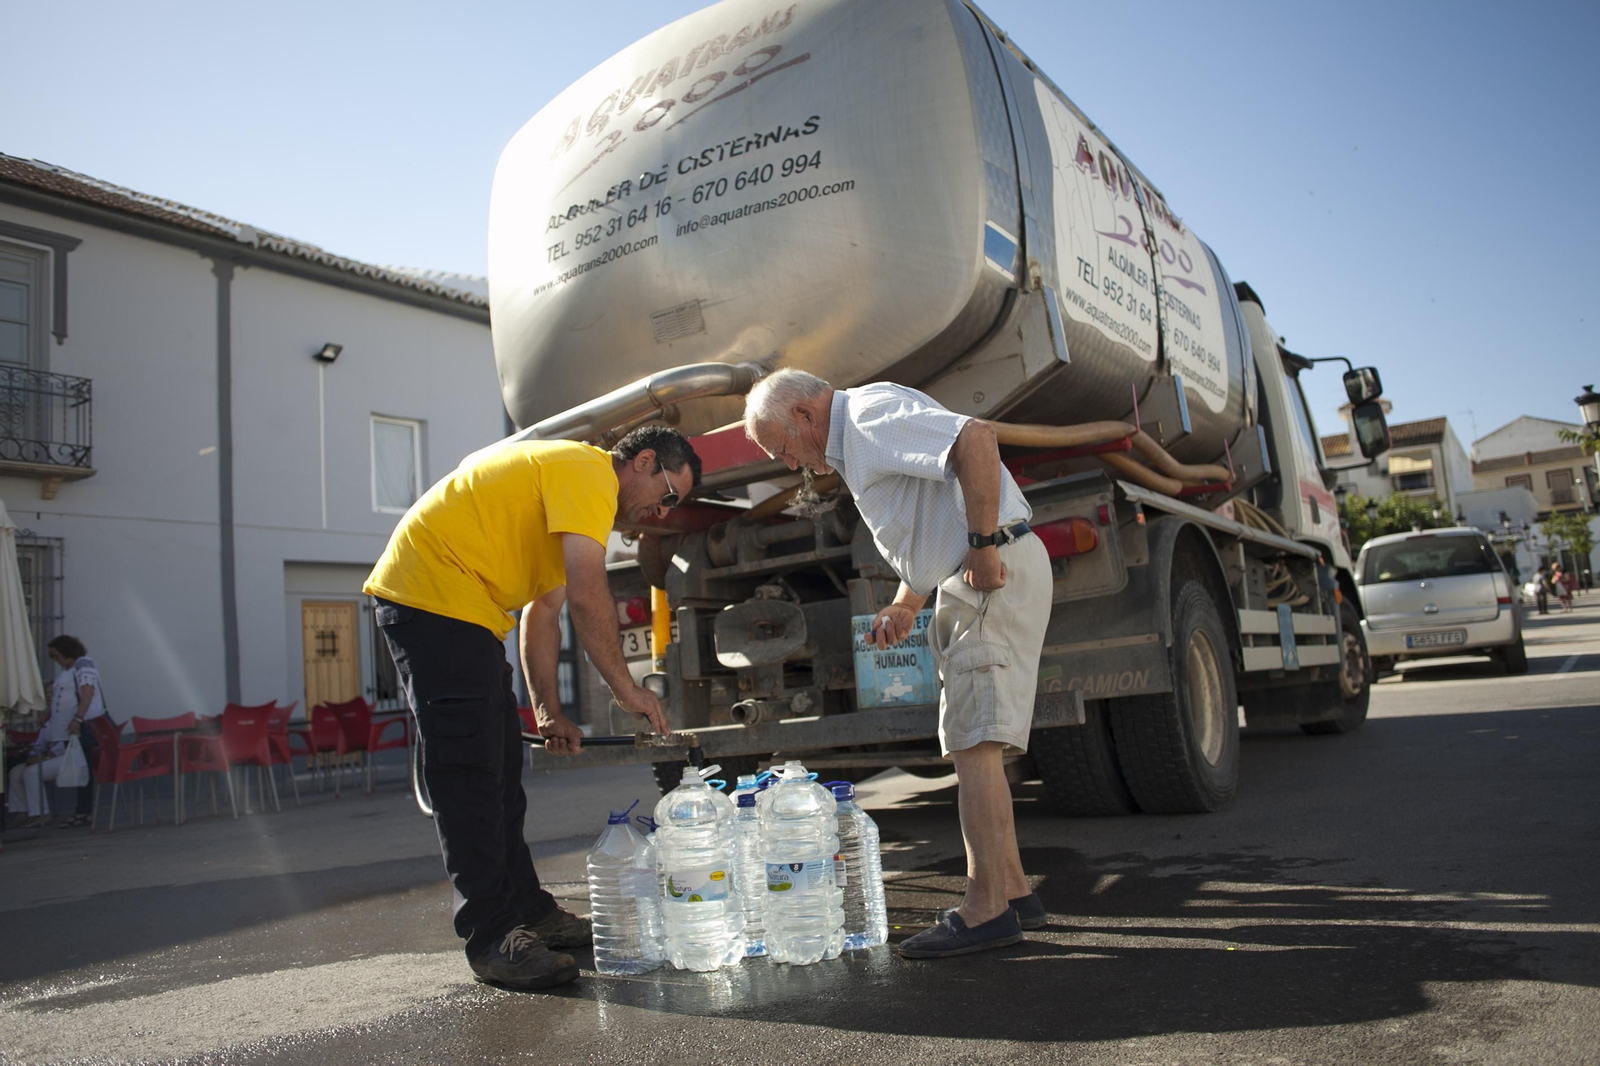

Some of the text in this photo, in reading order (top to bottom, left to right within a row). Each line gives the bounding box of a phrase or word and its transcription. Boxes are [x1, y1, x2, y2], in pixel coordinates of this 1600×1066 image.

[551, 3, 797, 161] AQUATRANS
[546, 115, 821, 234] ALQUILER DE CISTERNAS
[575, 225, 601, 250] 952
[606, 215, 623, 237] 31
[627, 205, 648, 228] 64
[654, 196, 672, 218] 16
[692, 178, 728, 204] 670
[735, 163, 774, 191] 640
[781, 150, 822, 178] 994
[675, 179, 856, 237] info@aquatrans2000.com
[533, 234, 658, 296] www.aquatrans2000.com
[1107, 245, 1149, 291] ALQUILER
[1066, 286, 1153, 356] www.aquatrans2000.com
[1103, 276, 1124, 306] 952
[1126, 293, 1137, 315] 31
[1139, 303, 1152, 325] 64
[1174, 327, 1190, 352] 670
[1191, 340, 1206, 363] 640
[1208, 352, 1221, 372] 994
[875, 653, 917, 670] HUMANO
[893, 630, 930, 649] CONSUM
[1068, 670, 1150, 694] CAMION
